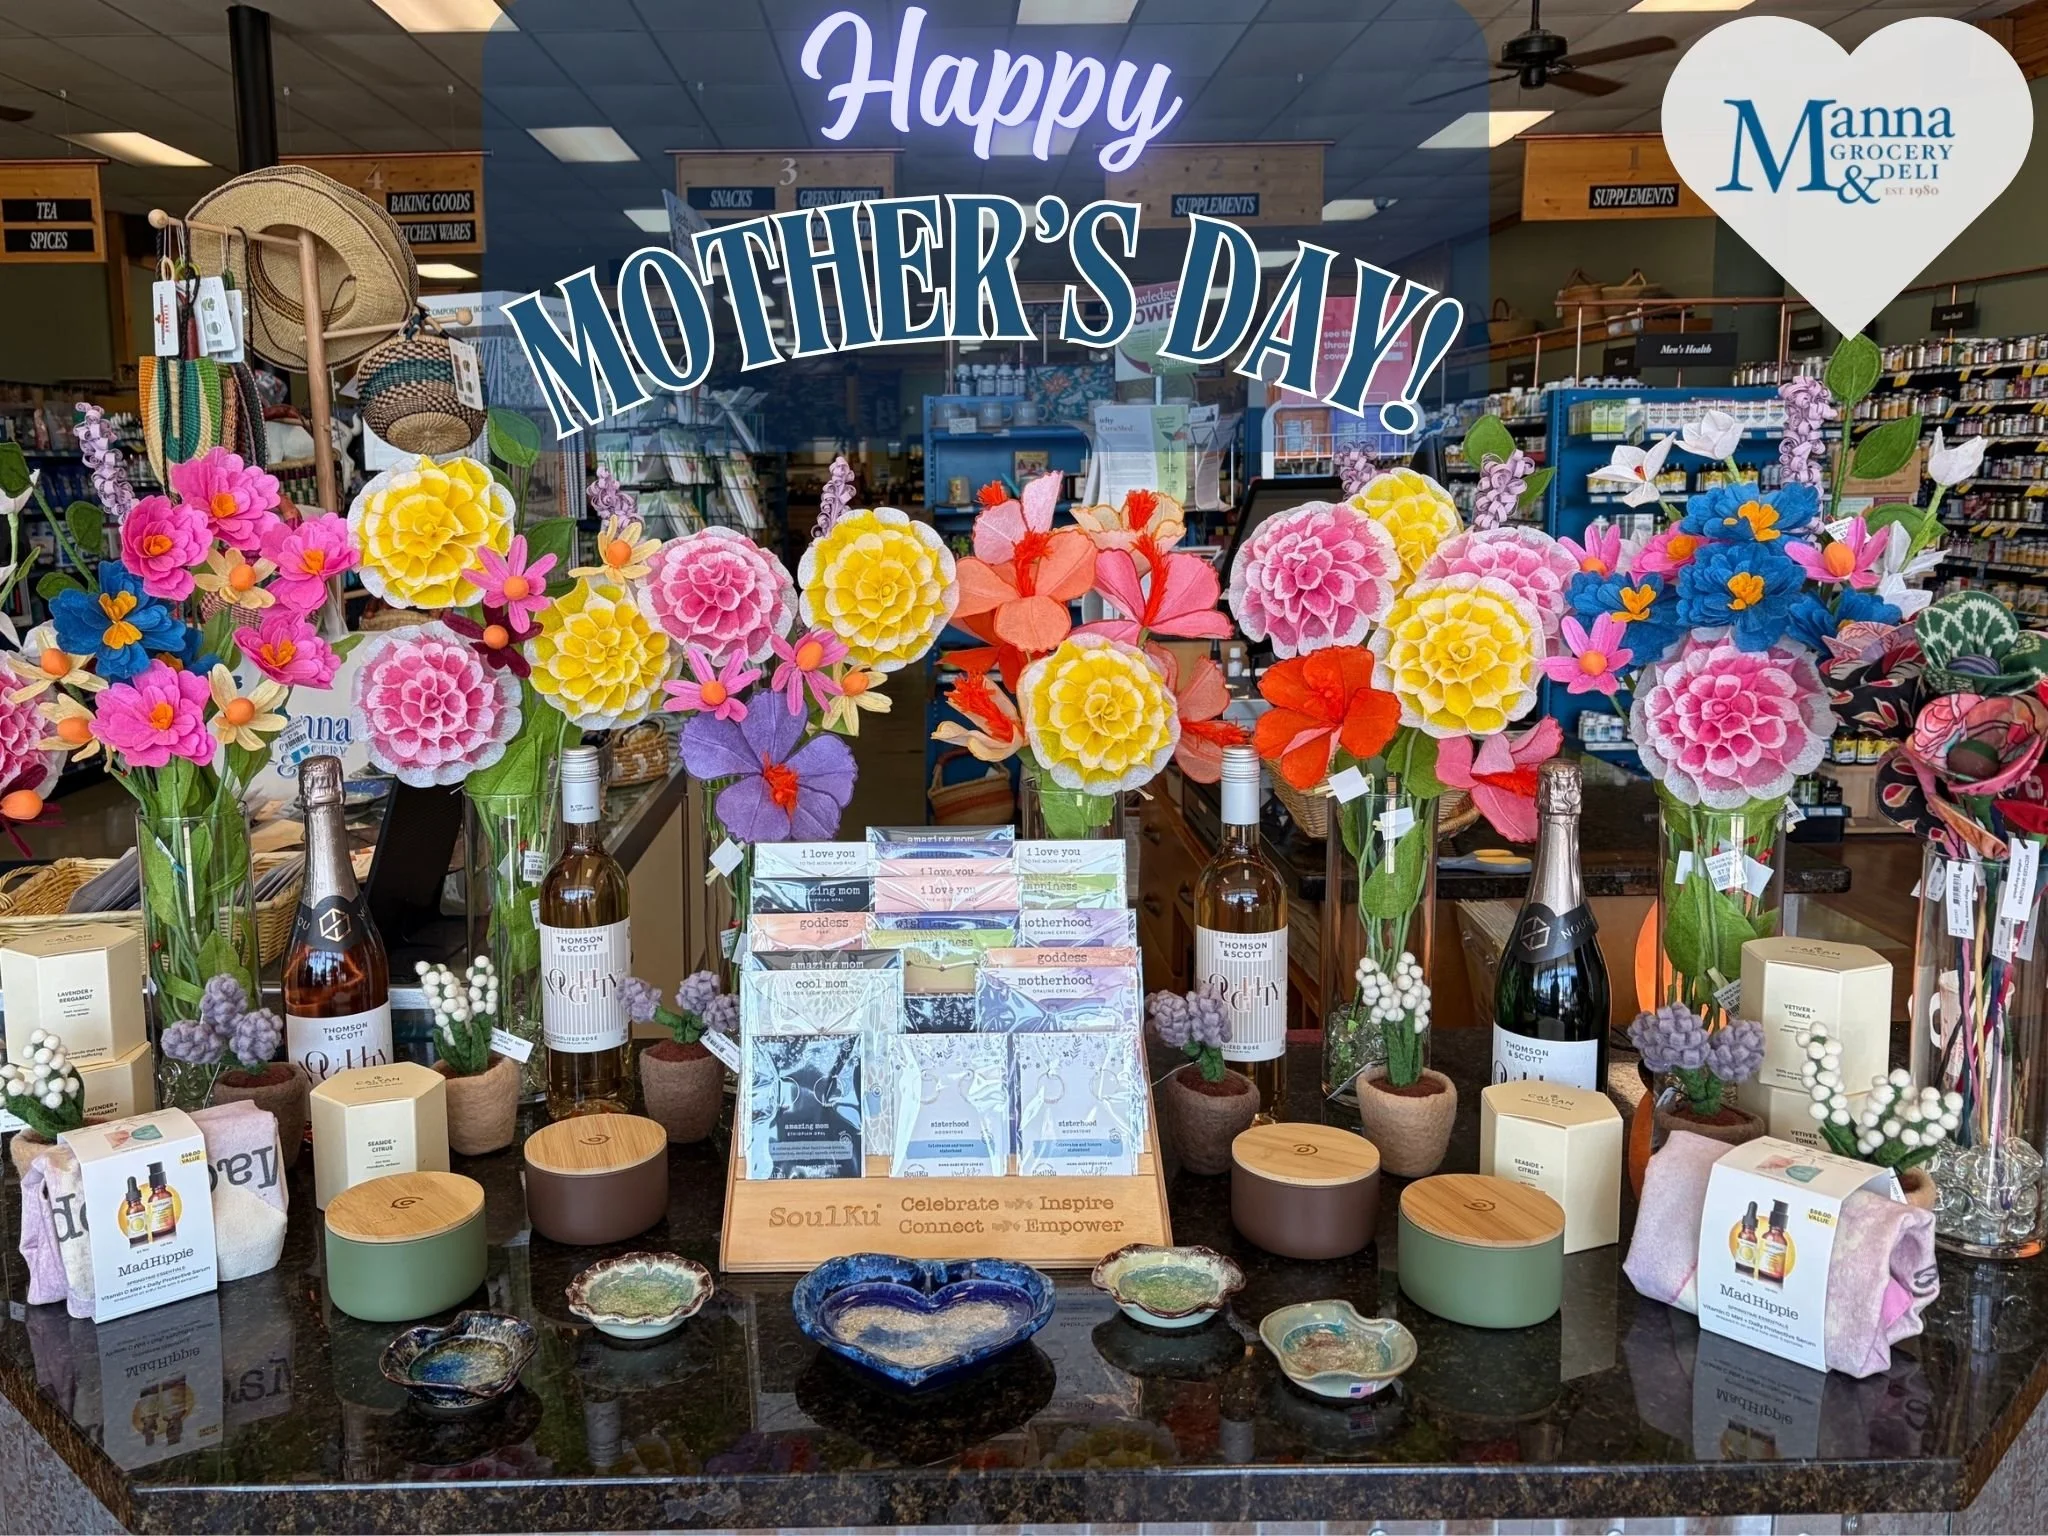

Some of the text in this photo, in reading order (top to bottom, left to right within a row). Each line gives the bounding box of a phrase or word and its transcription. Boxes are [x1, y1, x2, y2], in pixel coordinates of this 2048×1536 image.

[366, 162, 384, 190] 4
[780, 157, 797, 186] 3
[709, 189, 753, 208] SNACKS
[1593, 187, 1675, 206] SUPPLEMENTS
[391, 192, 471, 213] BAKING GOODS
[1175, 196, 1256, 215] SUPPLEMENTS
[36, 201, 58, 219] TEA
[439, 222, 471, 241] WARES
[29, 231, 68, 249] SPICES
[1323, 330, 1340, 338] see
[1660, 343, 1713, 355] Men's Health
[809, 849, 834, 859] love
[835, 850, 856, 860] you
[1035, 847, 1059, 857] love
[1061, 848, 1081, 858] you
[929, 867, 954, 876] love
[955, 867, 975, 877] you
[838, 887, 861, 895] mom
[929, 886, 954, 895] love
[955, 887, 977, 897] you
[799, 917, 849, 931] goddess
[556, 935, 604, 945] THOMSON
[1219, 940, 1268, 951] THOMSON
[560, 943, 599, 953] & SCOTT
[1037, 953, 1088, 965] goddess
[1231, 950, 1262, 959] SCOTT
[790, 960, 865, 970] amazing mom
[795, 980, 849, 989] cool mom
[1018, 975, 1094, 986] motherhood
[57, 989, 89, 998] LAVENDER
[59, 994, 93, 1003] BERGAMOT
[1784, 1003, 1811, 1013] VETIVER
[1788, 1011, 1811, 1020] TONKA
[323, 1021, 368, 1035] THOMSON
[335, 1030, 364, 1041] SCOTT
[1506, 1040, 1549, 1057] THOMSON
[1514, 1052, 1544, 1065] SCOTT
[84, 1102, 114, 1113] LAVENDER
[784, 1123, 814, 1131] amazing
[1058, 1120, 1097, 1128] sisterhood
[1790, 1130, 1818, 1139] VETIVER
[367, 1139, 392, 1147] SEASIDE
[1795, 1137, 1818, 1146] TONKA
[371, 1145, 393, 1153] CITRUS
[181, 1155, 201, 1164] VALUE
[1514, 1158, 1540, 1168] SEASIDE
[1517, 1166, 1540, 1176] CITRUS
[901, 1195, 1114, 1214] Celebrate Inspire
[769, 1203, 881, 1229] SoulKu
[1808, 1213, 1831, 1224] VALUE
[899, 1219, 1124, 1236] Connect Empower
[118, 1247, 194, 1278] MadHippie
[101, 1291, 124, 1302] Vitamin
[147, 1279, 162, 1289] Daily
[162, 1271, 192, 1285] Protective
[191, 1265, 211, 1274] Serum
[1719, 1283, 1799, 1321] MadHippie
[1702, 1302, 1725, 1315] Vitamin
[1748, 1318, 1764, 1330] Daily
[1764, 1322, 1796, 1341] Protective
[1796, 1335, 1817, 1348] Serum
